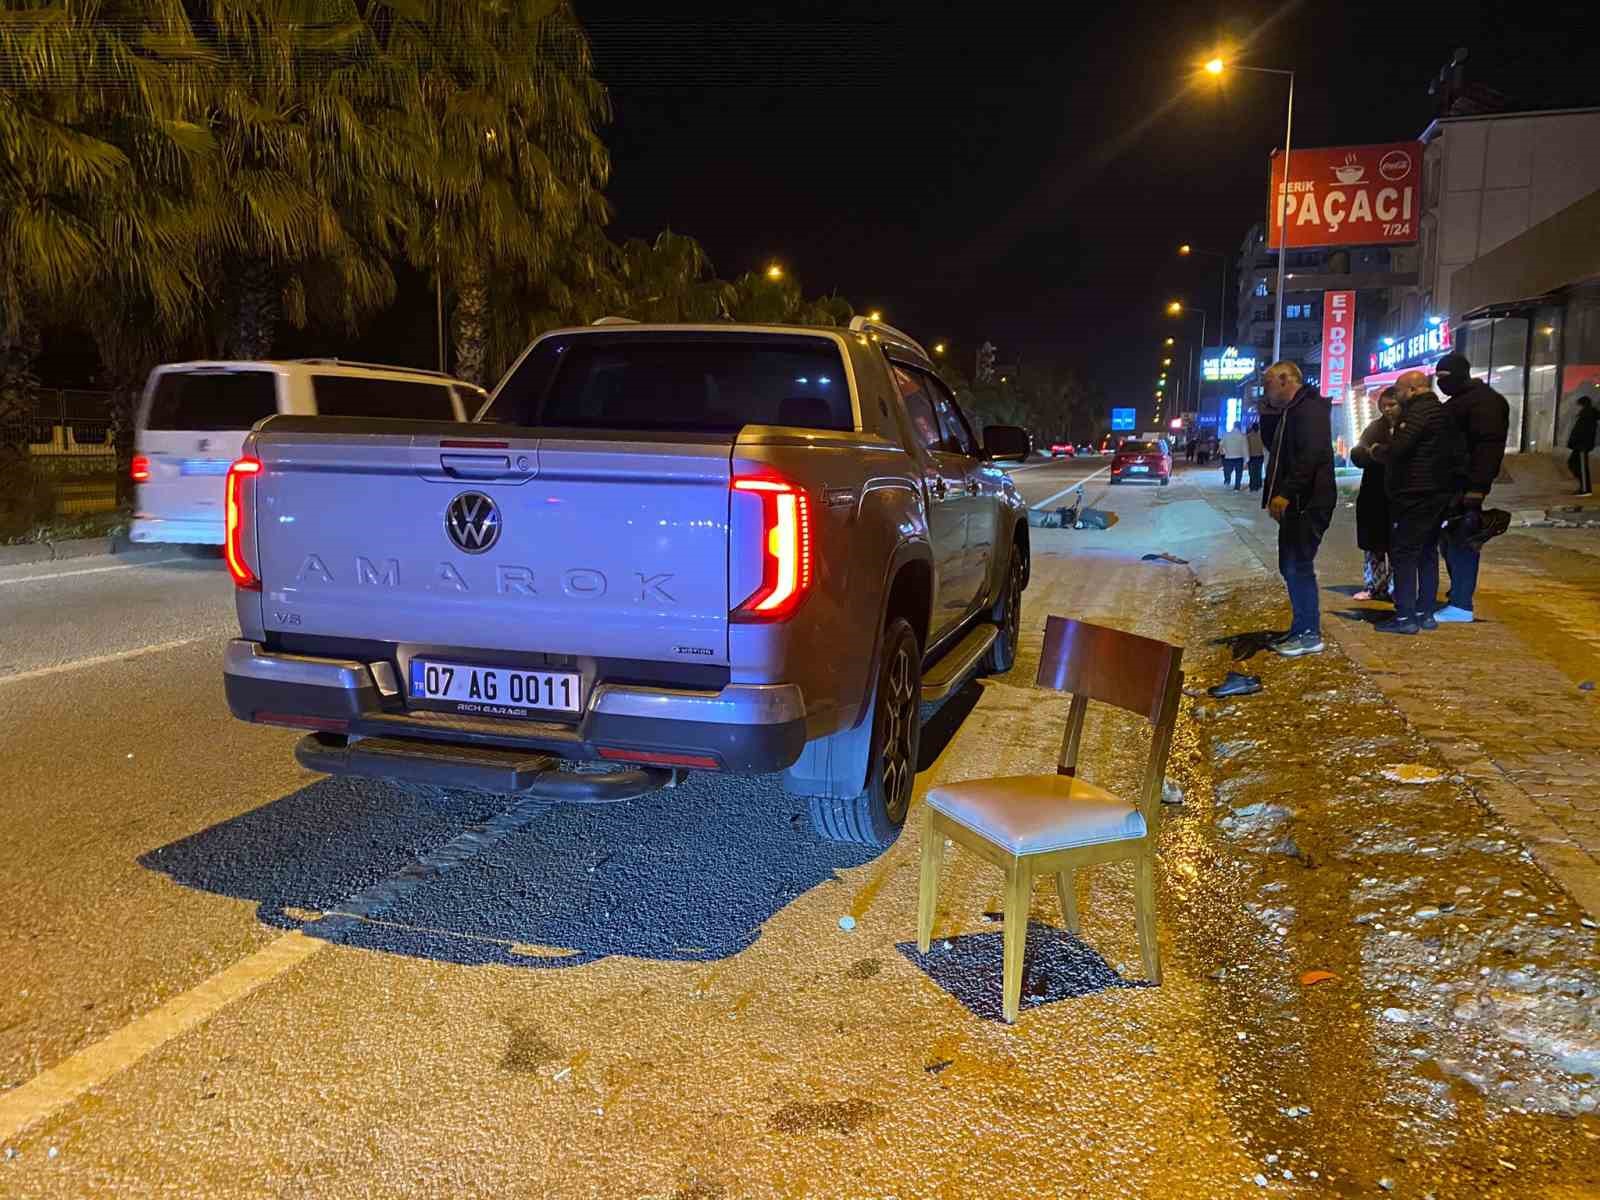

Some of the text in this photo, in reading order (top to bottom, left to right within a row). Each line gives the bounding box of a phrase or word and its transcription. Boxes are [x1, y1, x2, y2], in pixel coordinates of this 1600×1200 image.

[1276, 186, 1413, 233] PAÇACI
[1382, 223, 1411, 236] 7/24
[1331, 294, 1347, 323] ET
[298, 553, 677, 603] AMAROK
[426, 666, 571, 707] 07 AG 0011
[457, 703, 528, 717] RICH GARAGE
